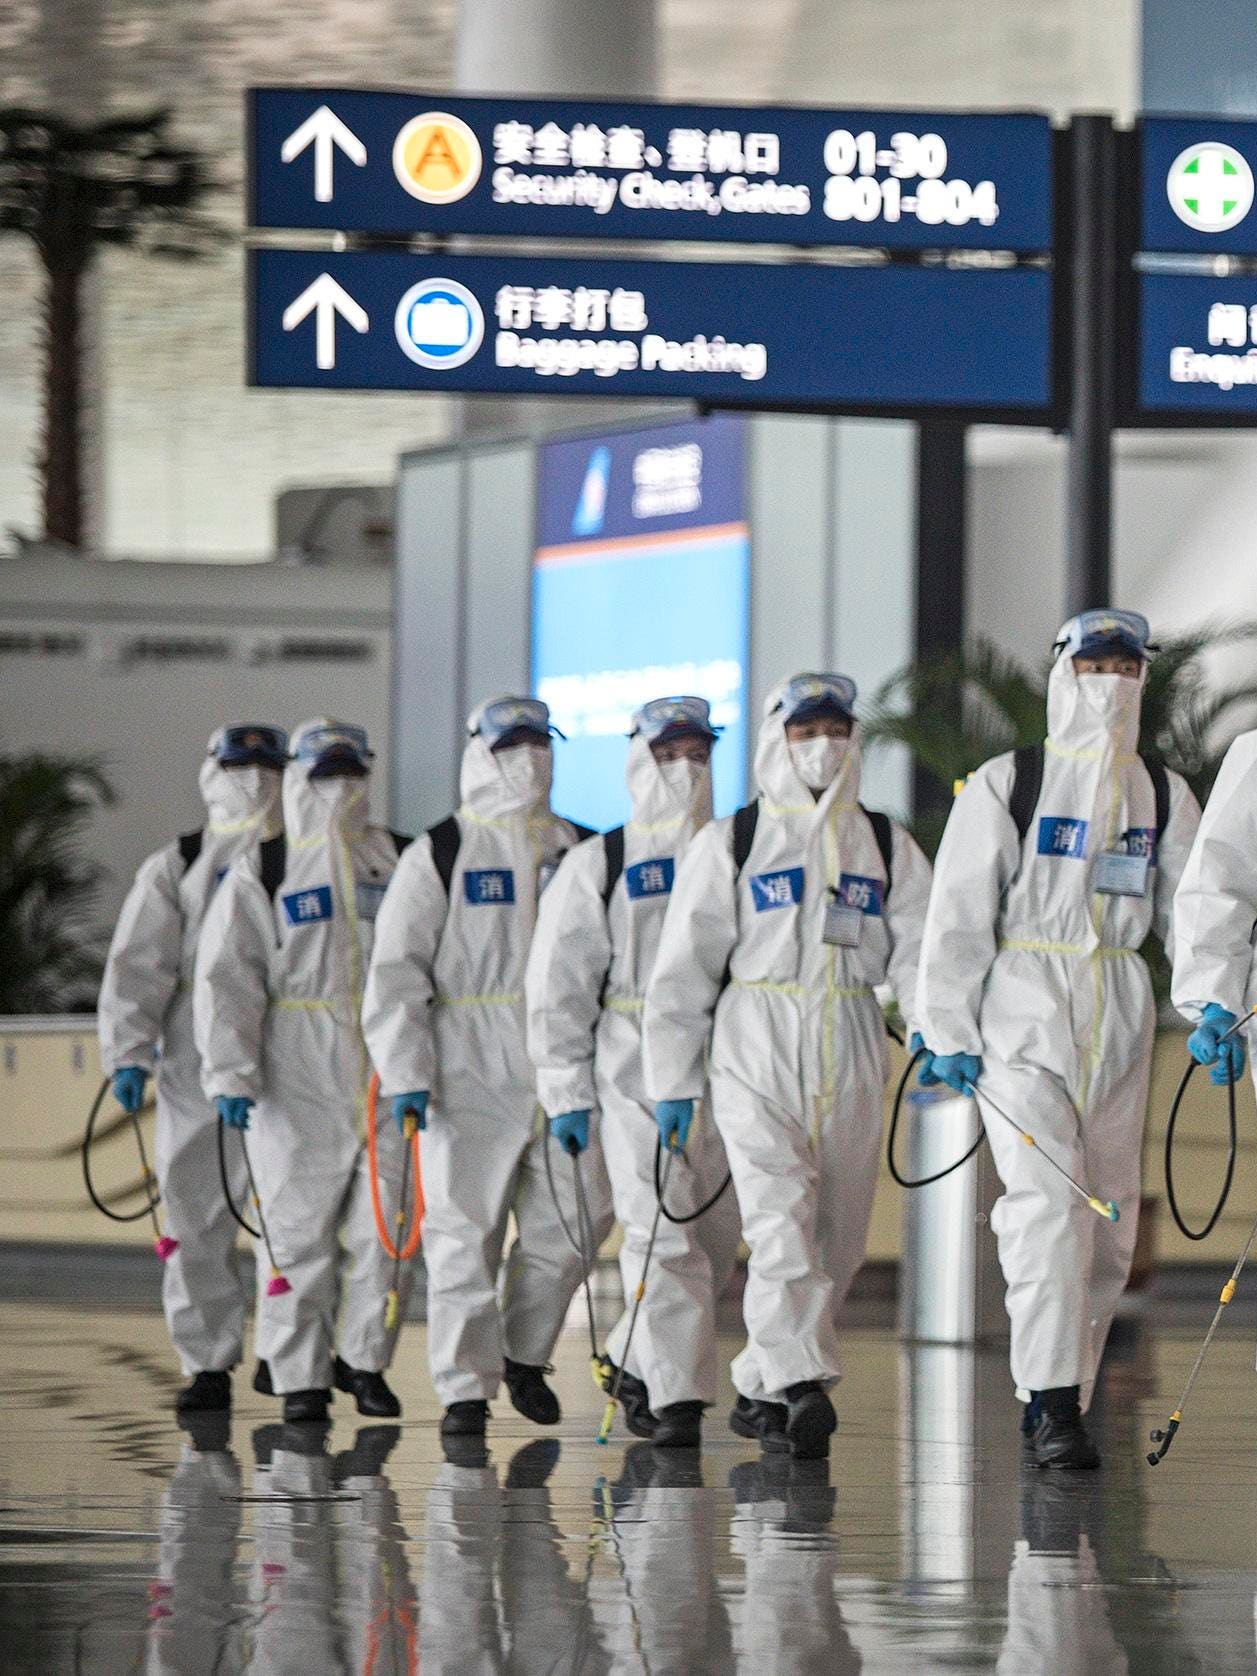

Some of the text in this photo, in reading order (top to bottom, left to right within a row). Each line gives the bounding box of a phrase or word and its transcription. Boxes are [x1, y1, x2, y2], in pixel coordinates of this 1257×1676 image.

[413, 127, 462, 180] A
[824, 129, 947, 179] 01-30
[493, 167, 618, 214] Security
[495, 285, 648, 332] 行李打包
[495, 331, 767, 380] Baggage Packing
[1053, 823, 1079, 851] 消
[479, 873, 505, 900] 消
[640, 863, 666, 891] 消
[766, 874, 793, 903] 消
[297, 893, 322, 919] 消
